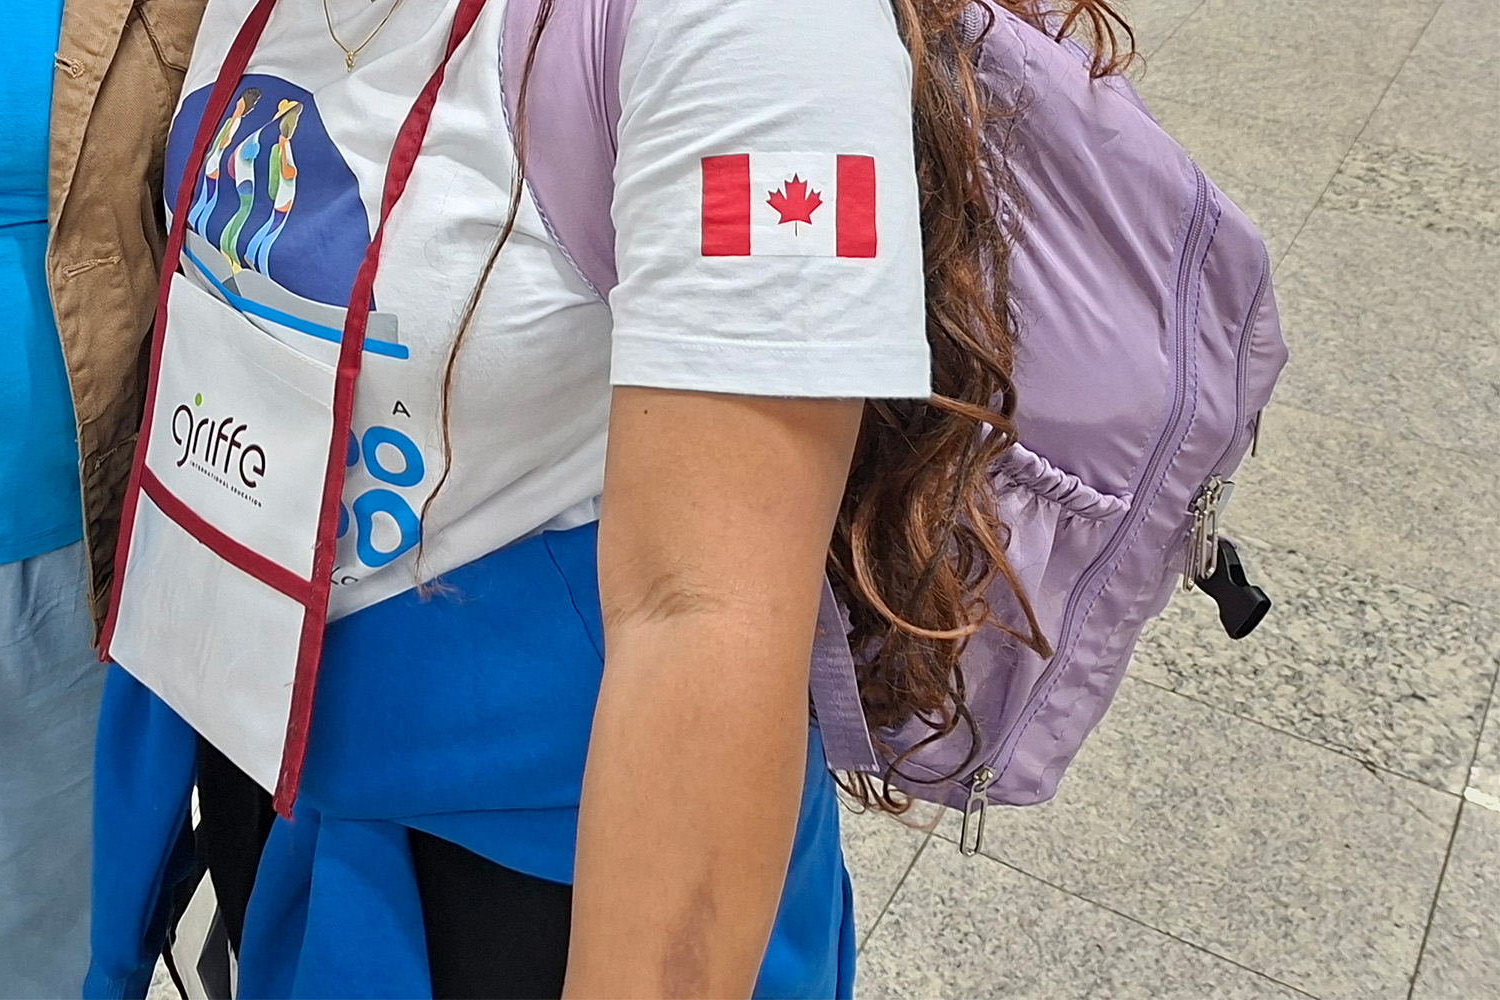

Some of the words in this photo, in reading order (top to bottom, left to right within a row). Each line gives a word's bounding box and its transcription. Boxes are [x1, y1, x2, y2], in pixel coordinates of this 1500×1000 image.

[171, 392, 267, 489] griffe
[189, 460, 229, 489] INTERNATIONAL
[230, 485, 263, 508] EDUCATION
